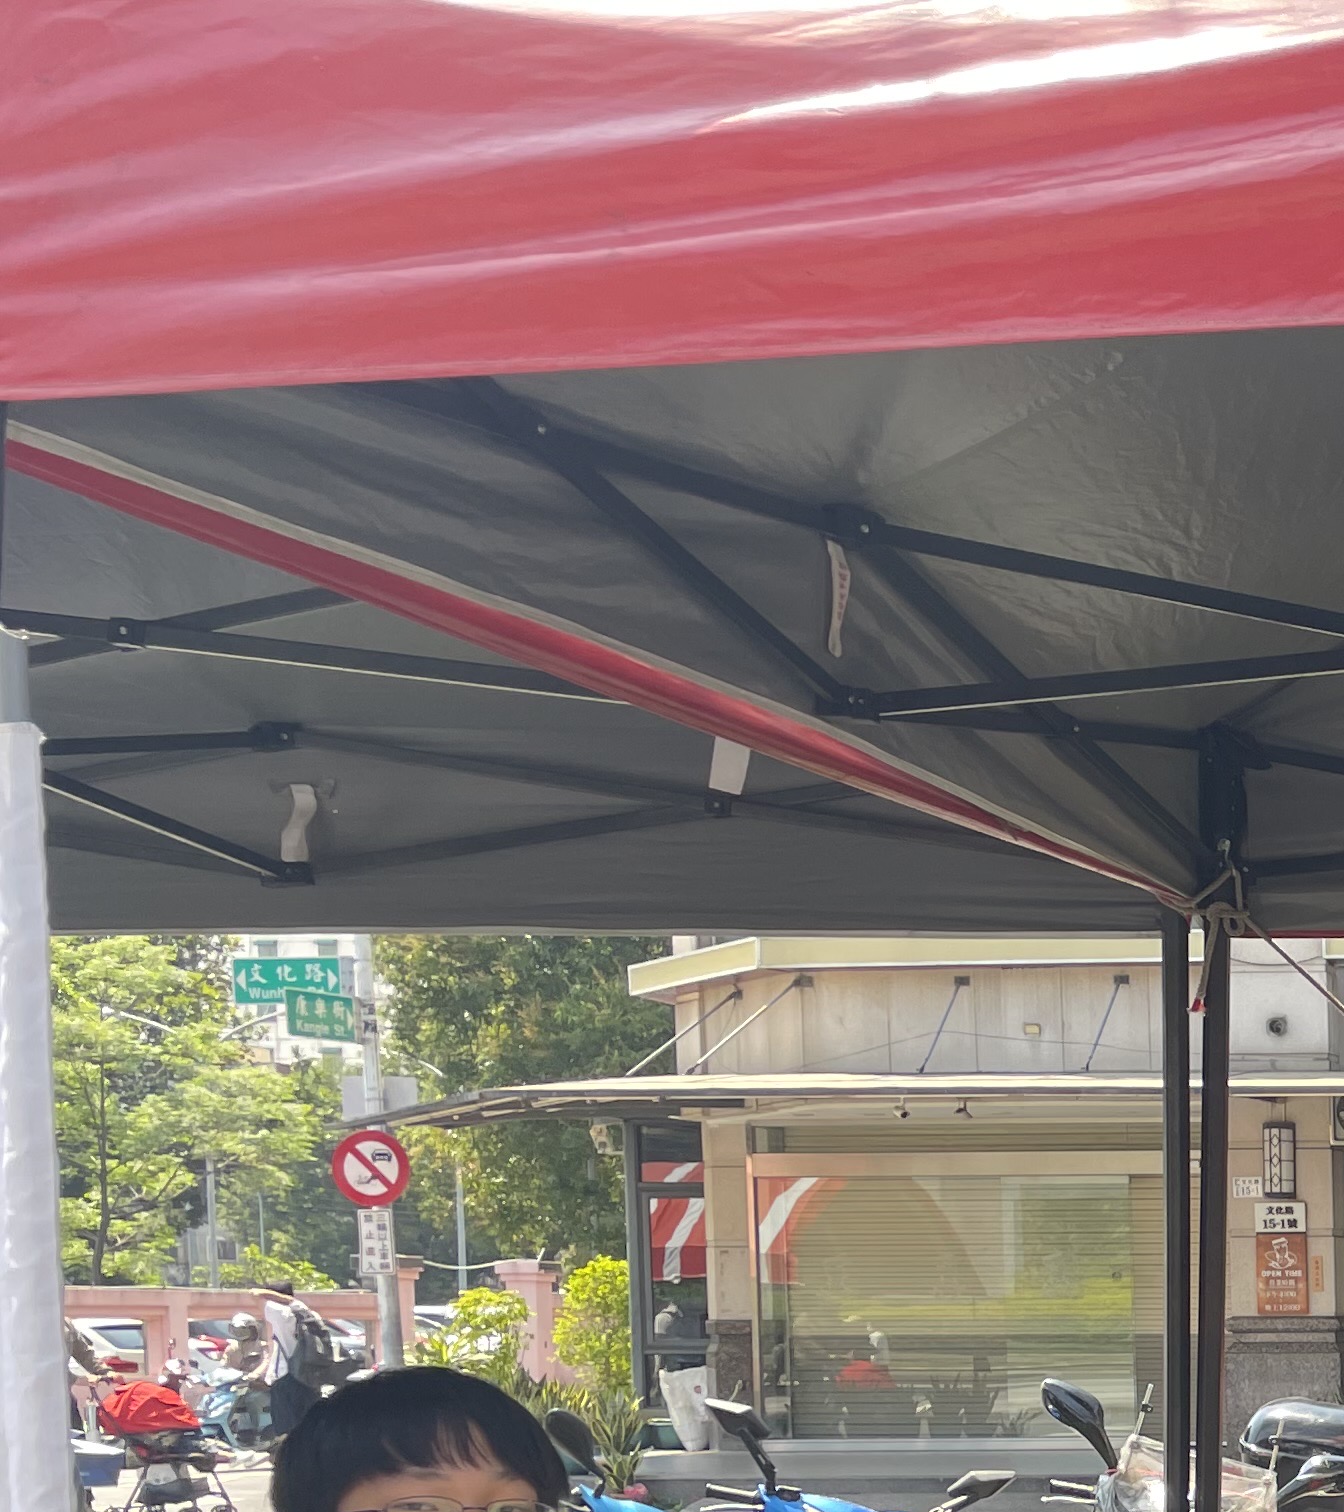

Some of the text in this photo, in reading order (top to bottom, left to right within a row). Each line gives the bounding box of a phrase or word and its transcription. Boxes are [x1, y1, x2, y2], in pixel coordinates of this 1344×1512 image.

[249, 963, 327, 984] 文化路
[1266, 1205, 1295, 1215] 文化路
[1261, 1270, 1282, 1278] OPEN
